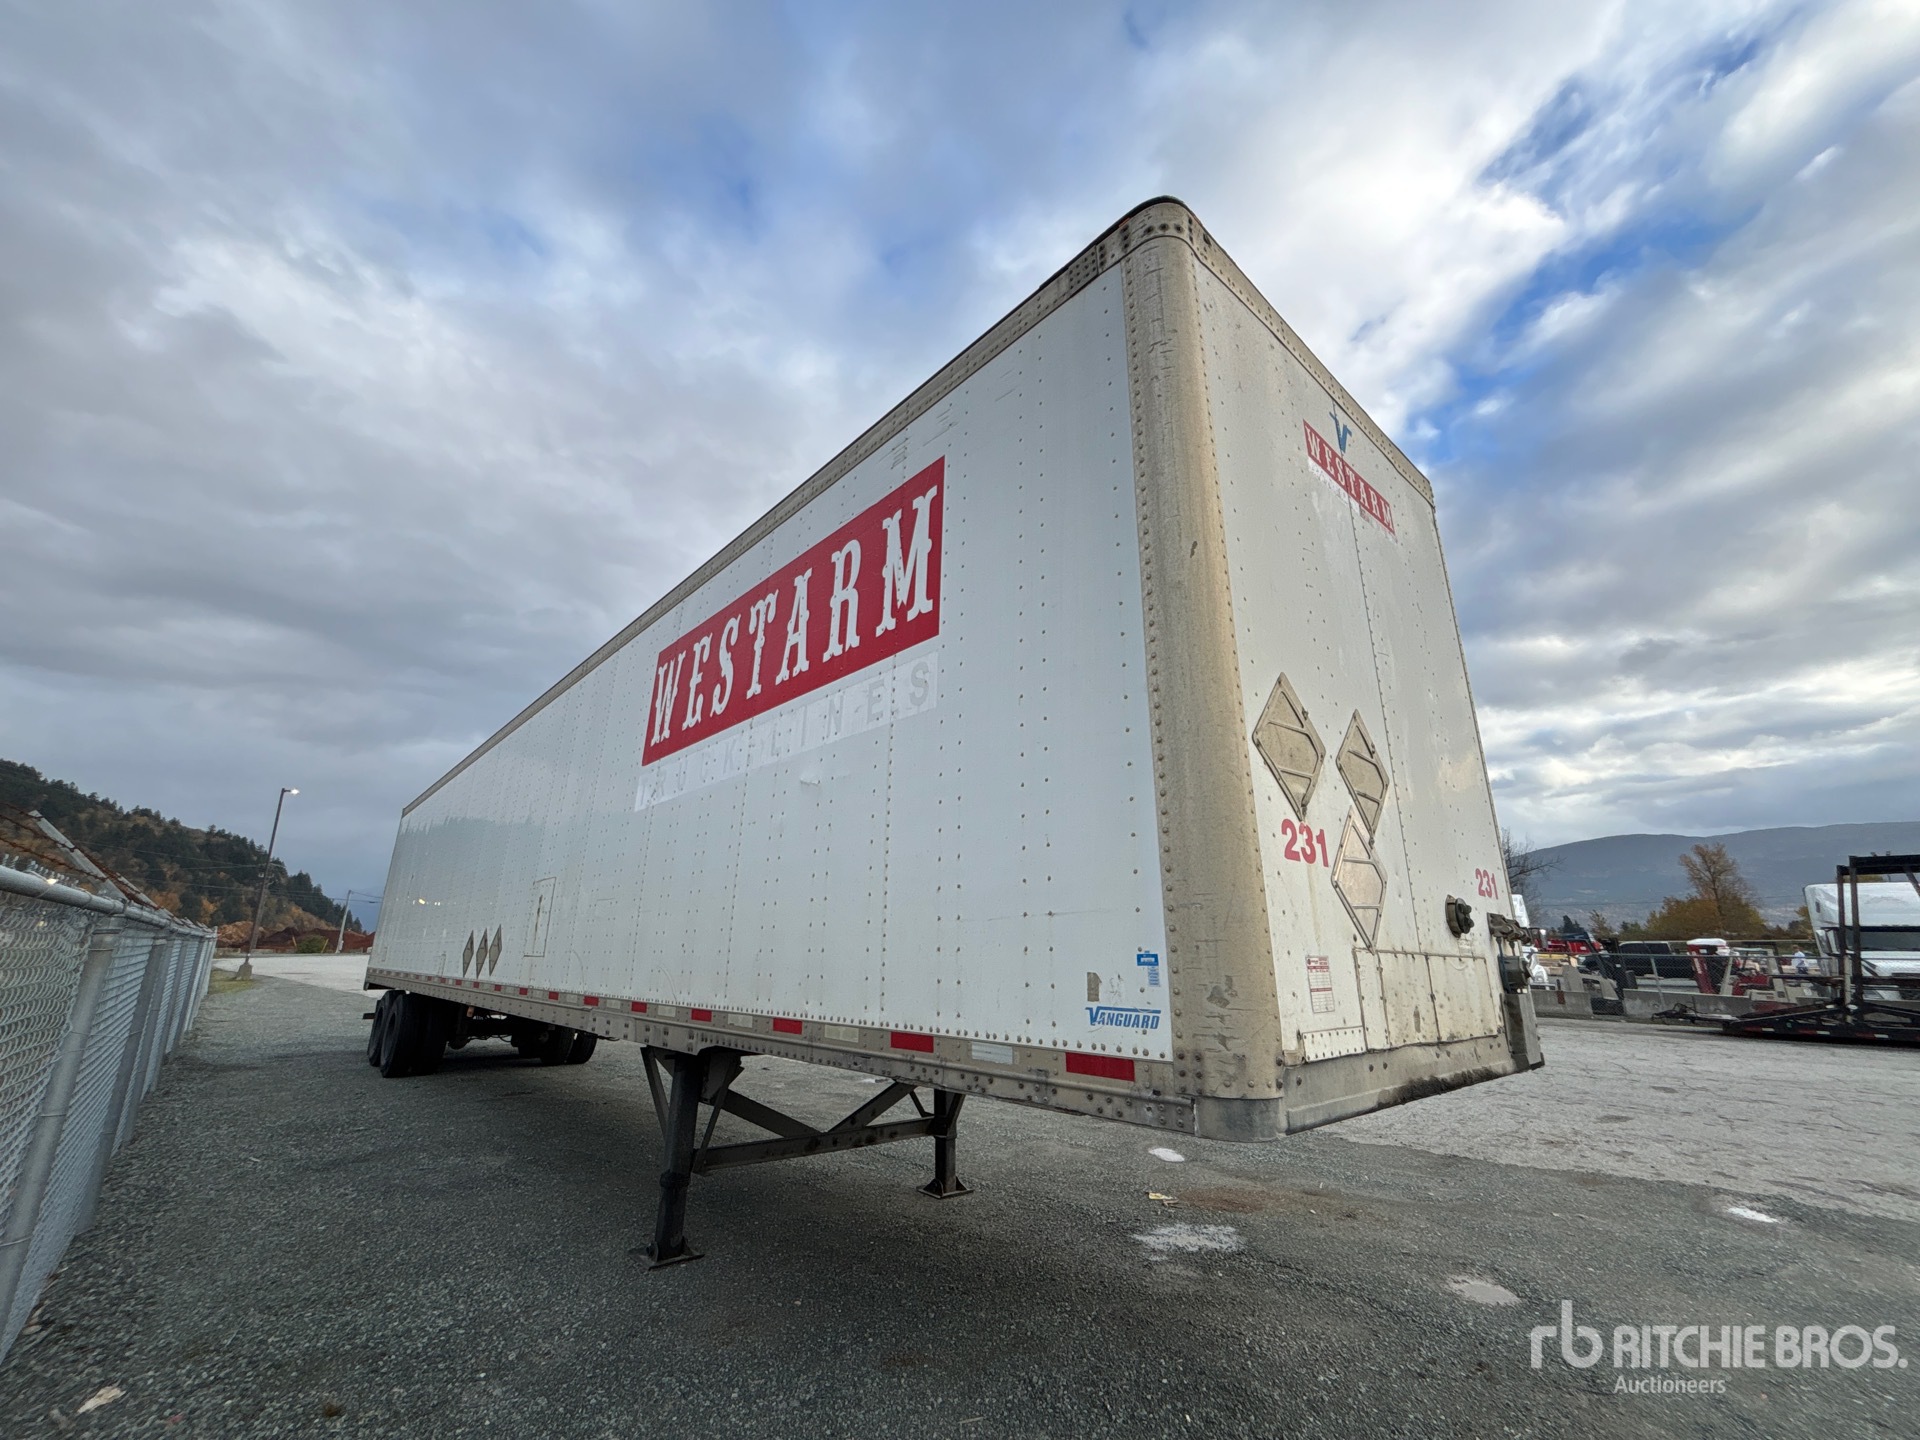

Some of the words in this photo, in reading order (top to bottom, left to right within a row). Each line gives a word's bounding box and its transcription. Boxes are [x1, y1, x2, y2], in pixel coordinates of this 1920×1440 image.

[1305, 426, 1393, 529] WESTARM
[651, 485, 938, 748] WESTARM
[1281, 818, 1330, 868] 231
[1475, 868, 1500, 900] 231
[1085, 1006, 1162, 1030] VANGUARD
